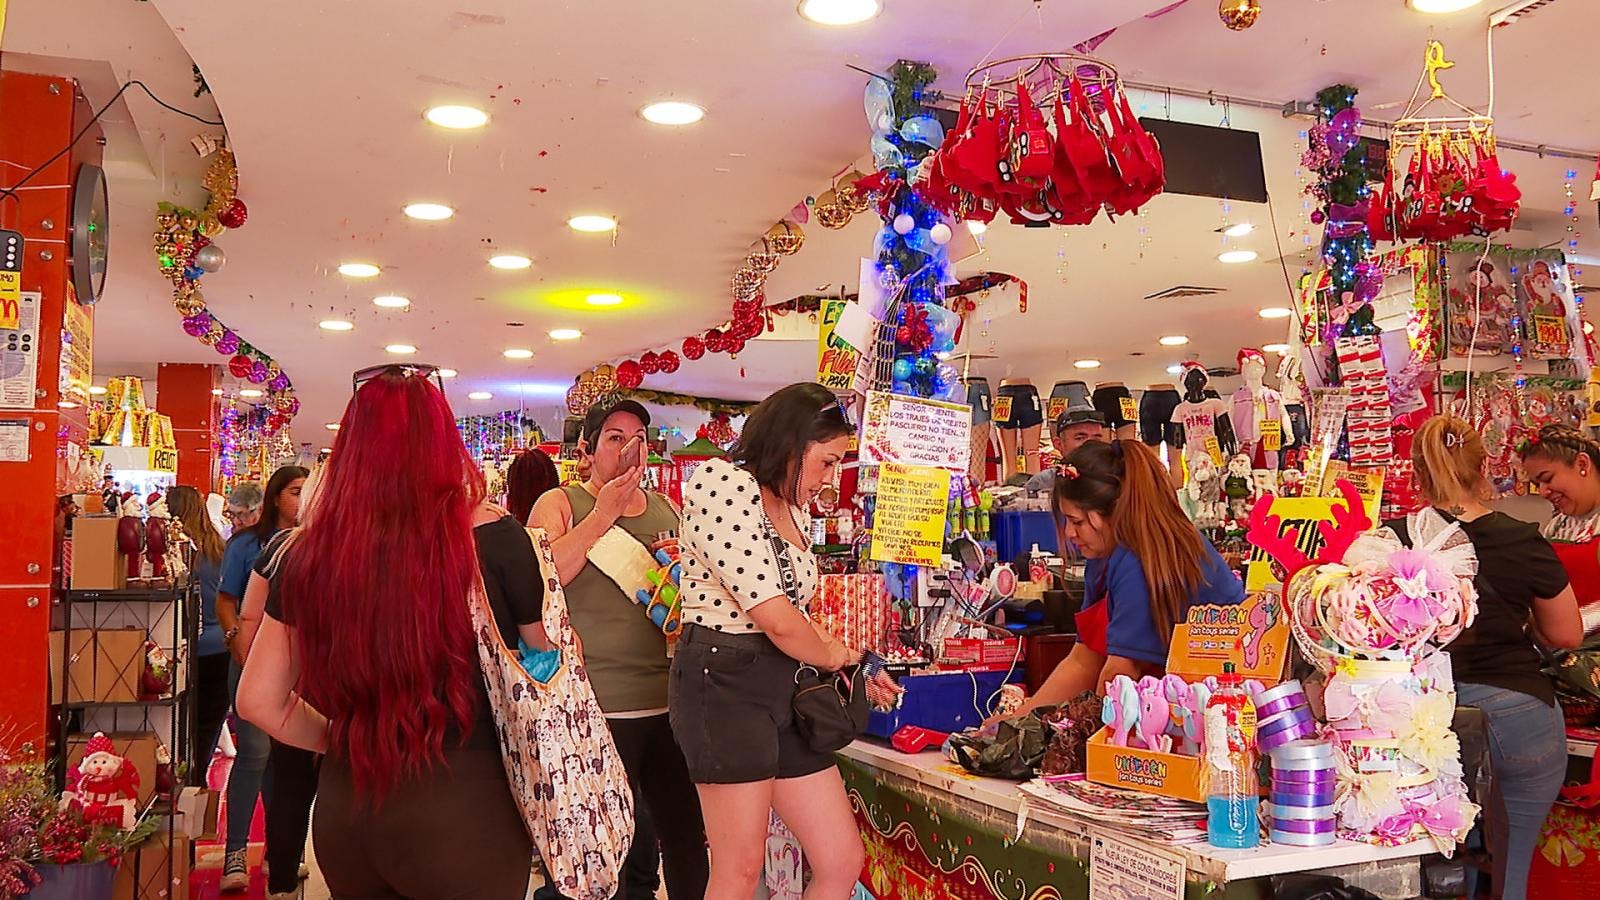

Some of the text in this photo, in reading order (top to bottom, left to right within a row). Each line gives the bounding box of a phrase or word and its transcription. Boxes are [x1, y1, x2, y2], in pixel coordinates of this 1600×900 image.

[890, 411, 904, 420] LOS
[906, 413, 930, 423] TRAJES
[890, 420, 927, 432] PASCUERO
[928, 426, 940, 434] NO
[908, 432, 936, 443] CAMBIO
[910, 452, 940, 462] GRACIAS
[1188, 608, 1248, 625] UNICORN
[1219, 626, 1240, 636] series
[1114, 754, 1168, 778] UNICORN
